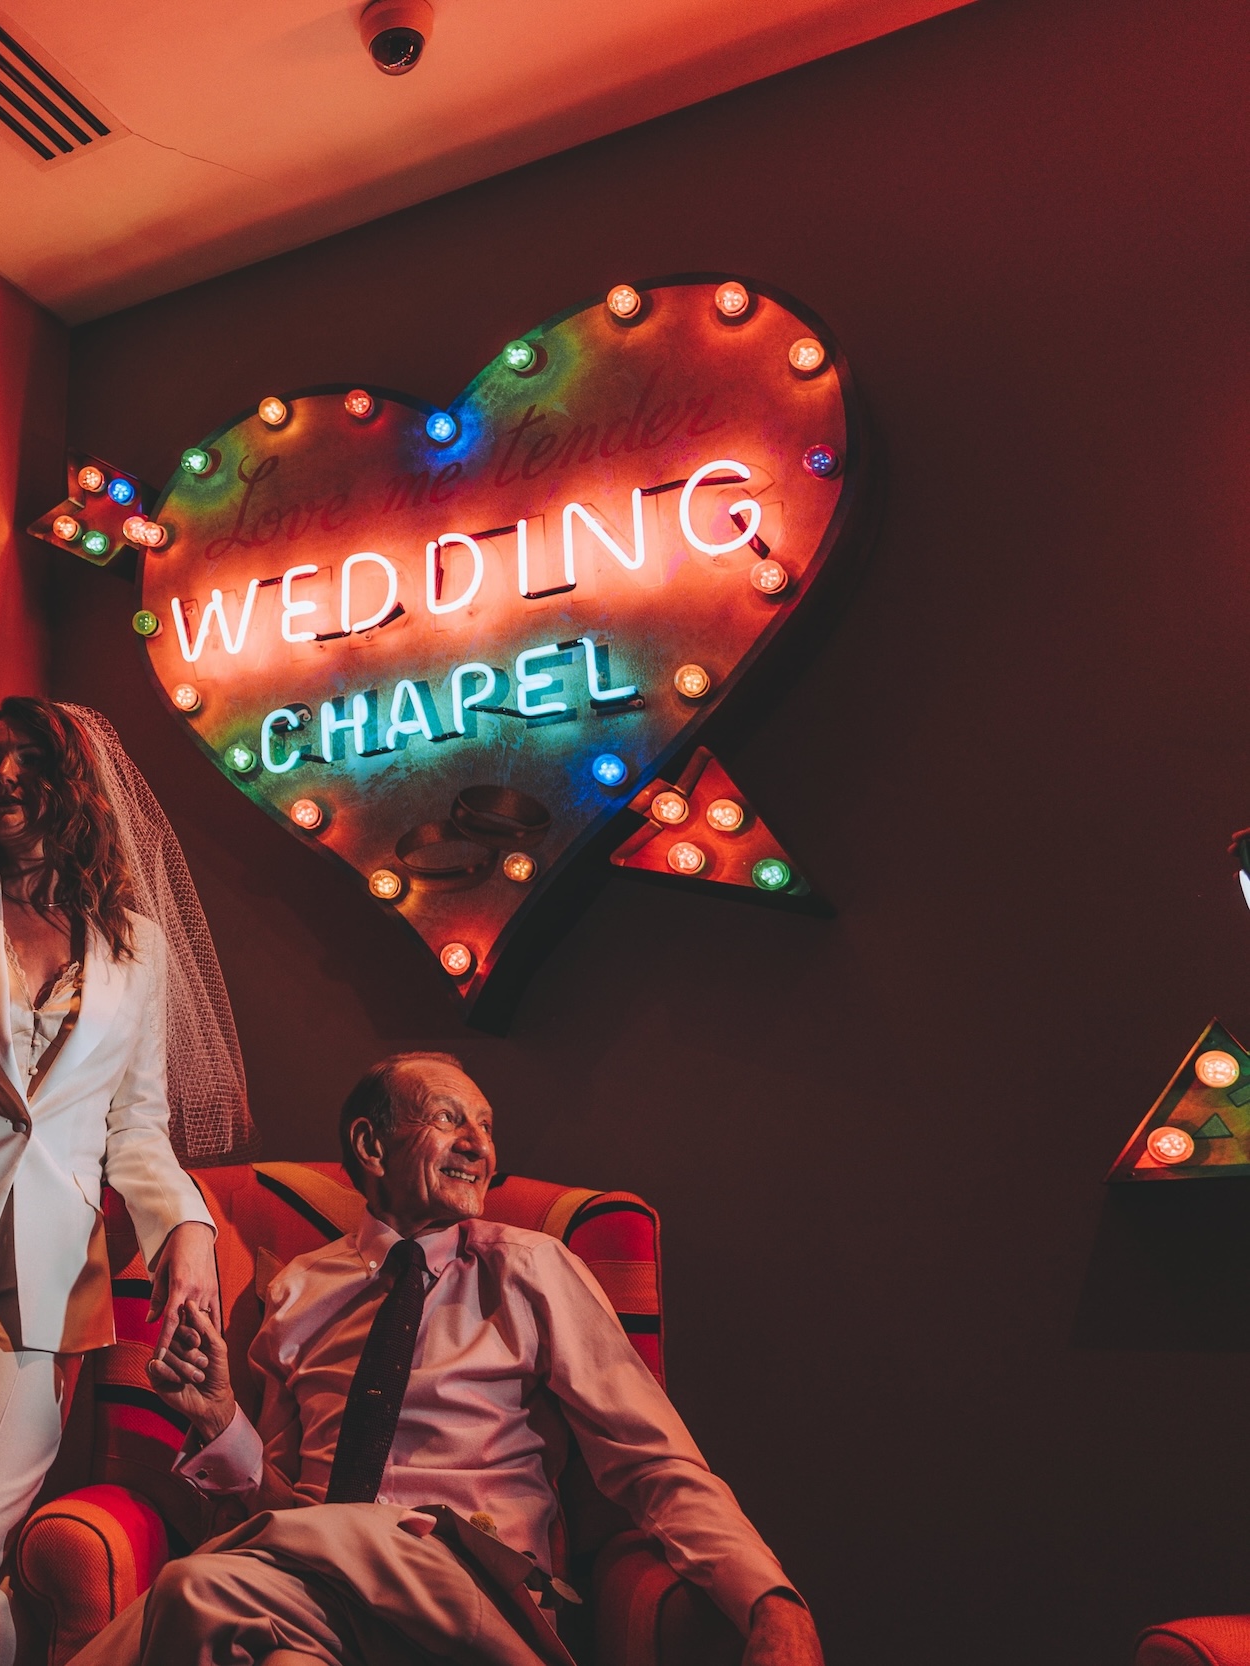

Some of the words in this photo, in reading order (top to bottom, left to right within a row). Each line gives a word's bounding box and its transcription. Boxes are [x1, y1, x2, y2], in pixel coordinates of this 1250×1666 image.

[204, 454, 351, 560] Love
[381, 461, 463, 515] me
[493, 360, 727, 487] tender
[170, 459, 763, 663] WEDDING
[260, 637, 640, 774] CHAPEL
